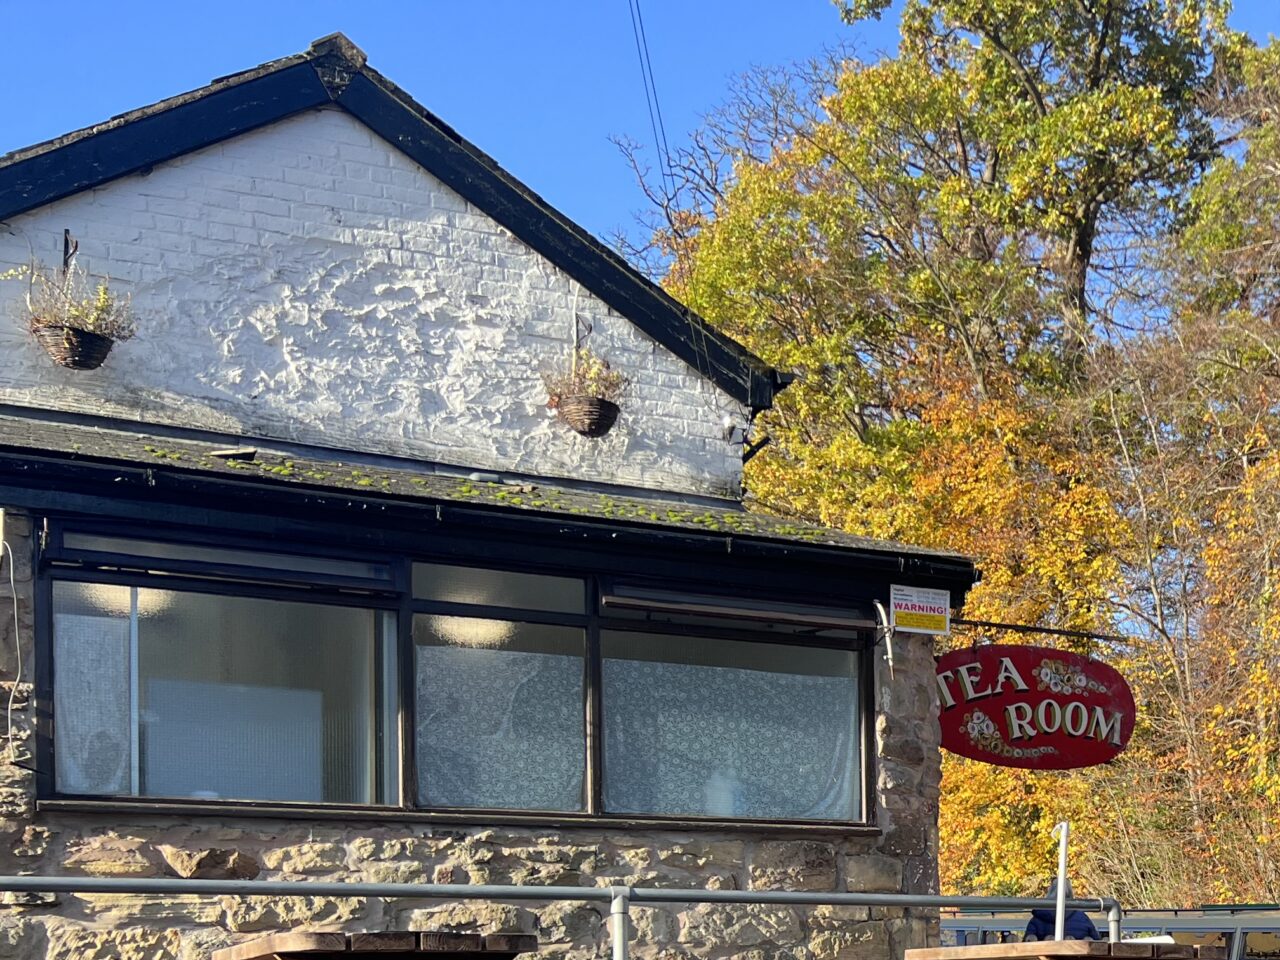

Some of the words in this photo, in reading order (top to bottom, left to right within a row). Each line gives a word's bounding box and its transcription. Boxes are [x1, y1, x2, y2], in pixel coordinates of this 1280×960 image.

[893, 602, 947, 614] WARNING!
[936, 657, 1030, 708] TEA
[1005, 699, 1124, 746] ROOM
